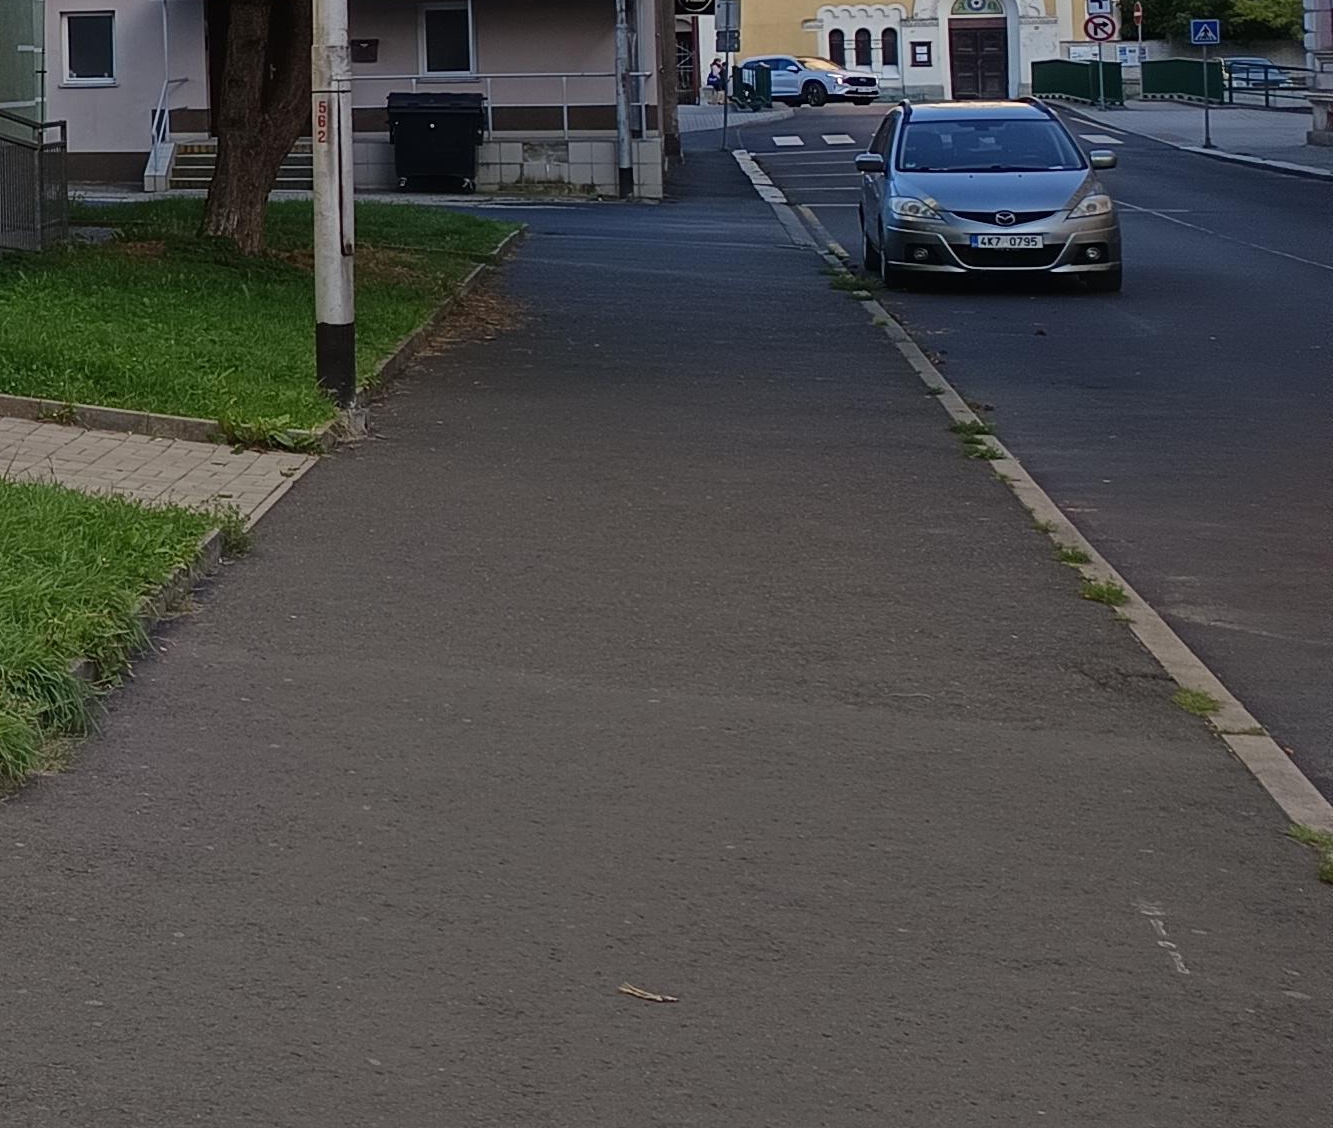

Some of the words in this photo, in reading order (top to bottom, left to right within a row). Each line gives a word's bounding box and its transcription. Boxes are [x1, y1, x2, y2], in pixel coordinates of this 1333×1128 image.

[318, 101, 327, 143] 562
[980, 236, 1001, 247] 4K7
[1009, 236, 1038, 247] 0795
